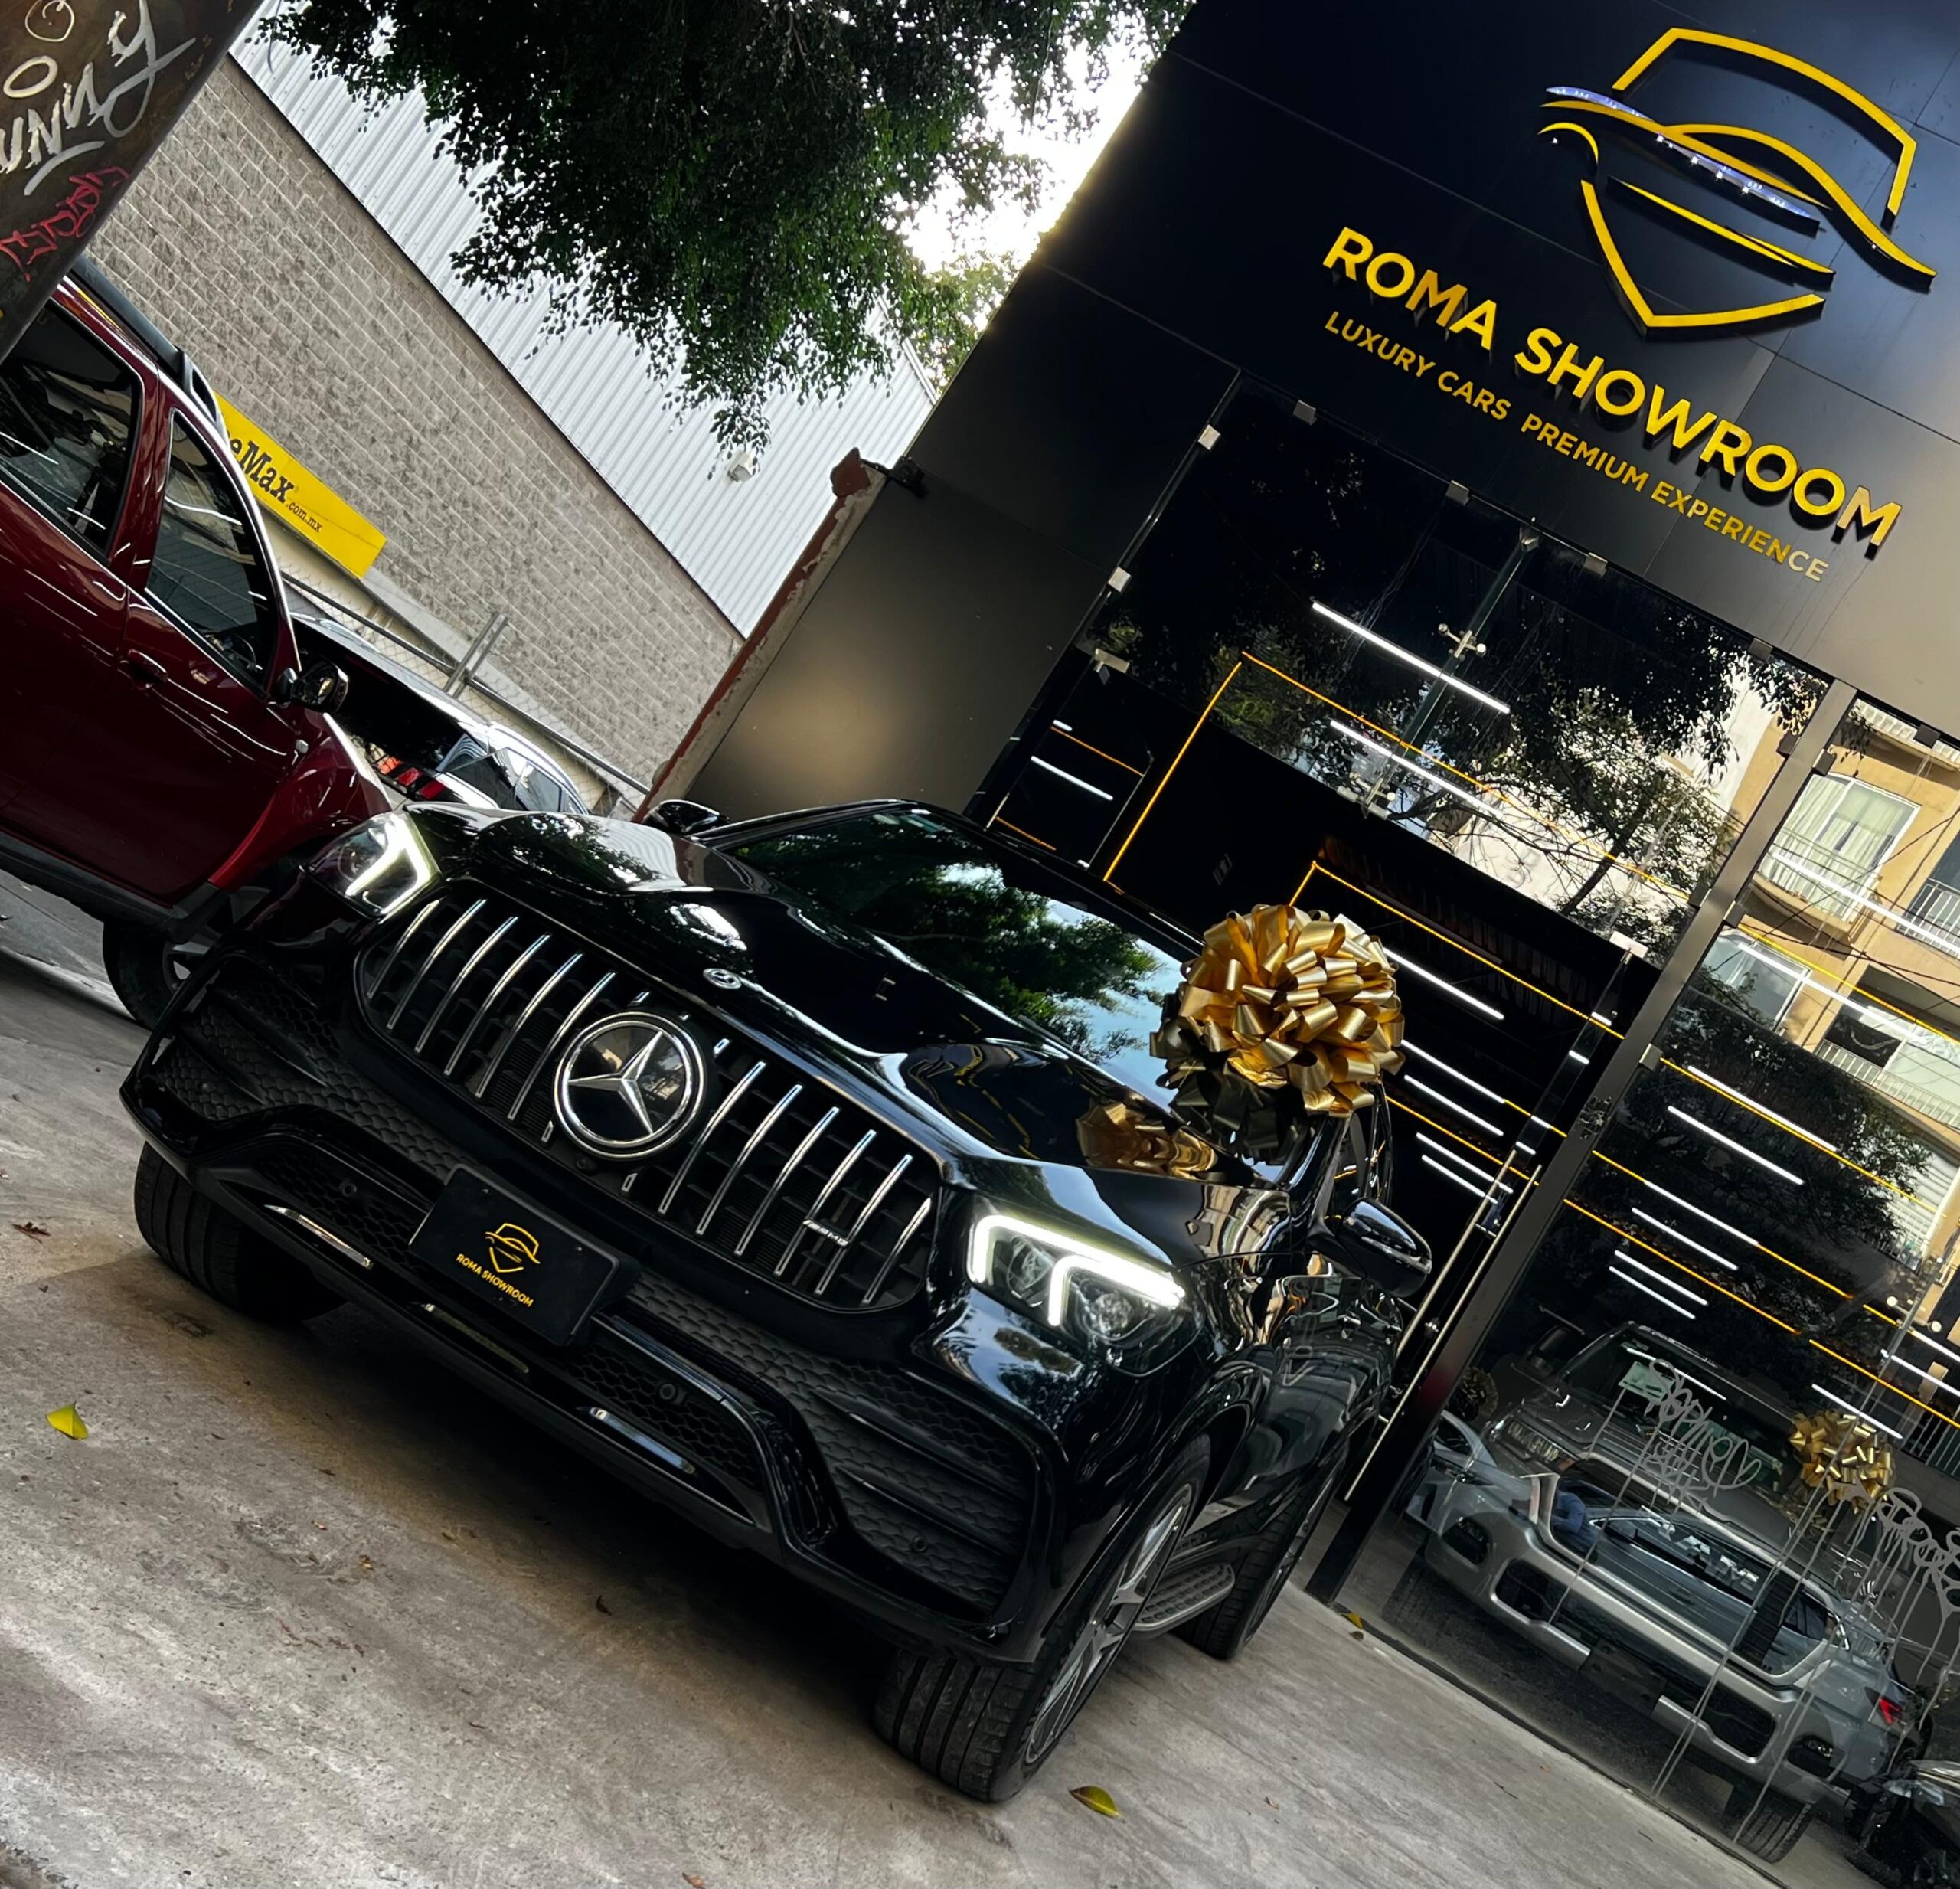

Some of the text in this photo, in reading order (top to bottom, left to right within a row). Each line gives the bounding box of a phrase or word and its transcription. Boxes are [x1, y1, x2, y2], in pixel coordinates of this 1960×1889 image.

[1321, 226, 1904, 548] ROMA SHOWROOM
[1324, 310, 1830, 583] LUXURY CARS PREMIUM EXPERIENCE
[455, 1253, 534, 1308] ROMA SHOWROOM
